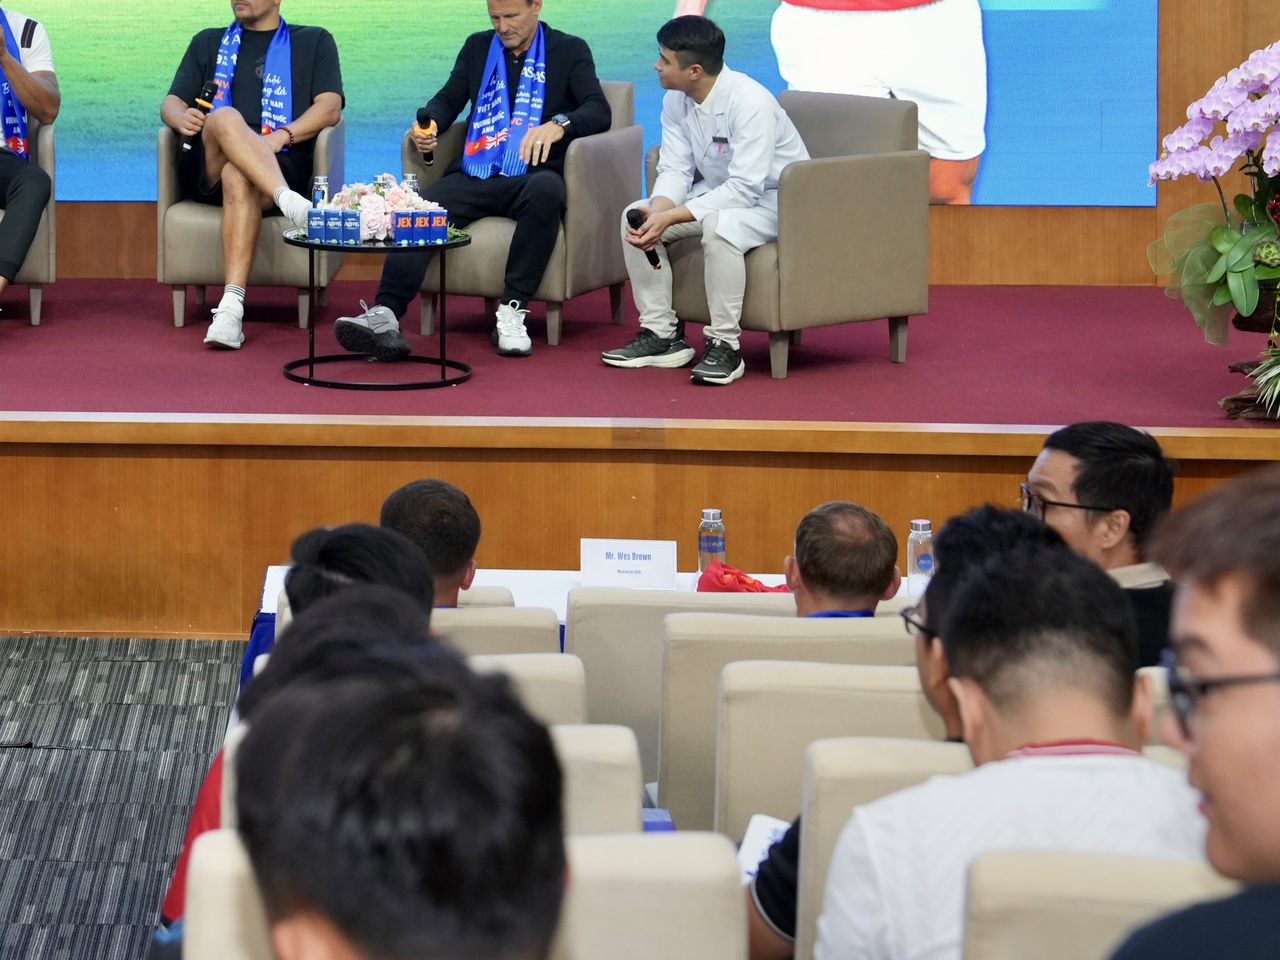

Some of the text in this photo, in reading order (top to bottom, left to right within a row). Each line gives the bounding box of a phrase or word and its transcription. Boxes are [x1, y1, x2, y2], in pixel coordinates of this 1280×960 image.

[397, 217, 412, 228] JEX
[414, 217, 429, 227] JEX
[432, 216, 447, 227] JEX
[606, 552, 652, 561] Mr. Wes Brown
